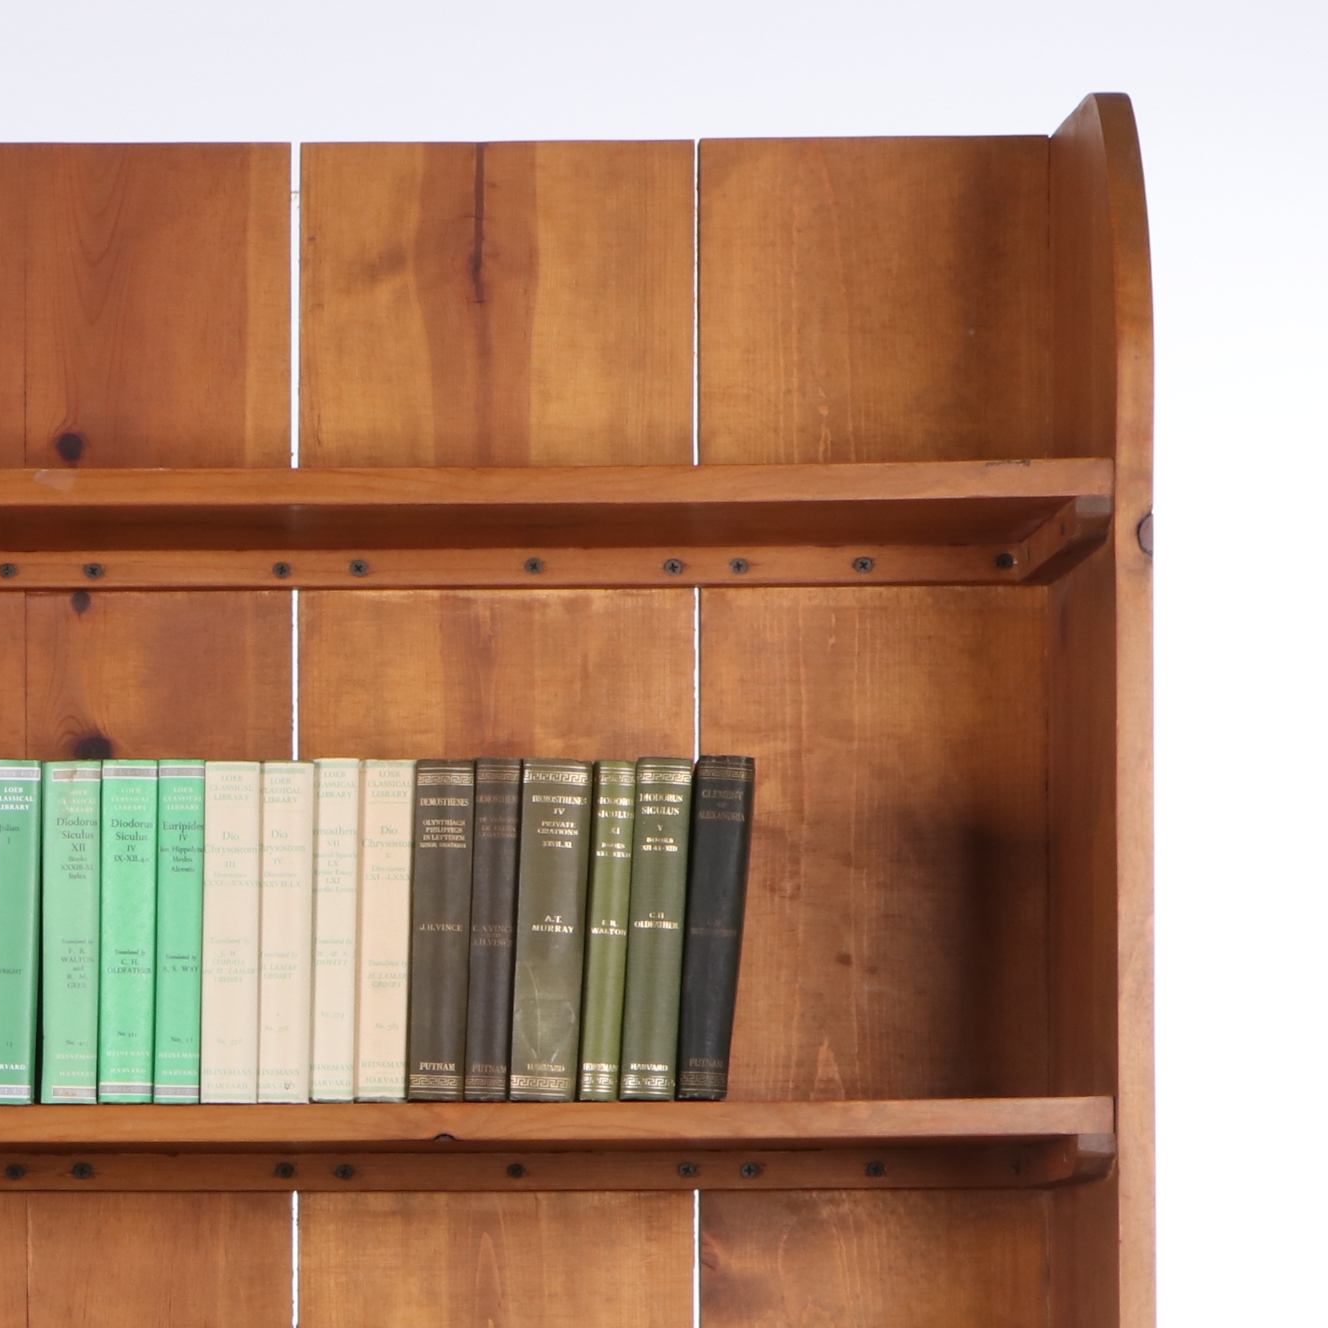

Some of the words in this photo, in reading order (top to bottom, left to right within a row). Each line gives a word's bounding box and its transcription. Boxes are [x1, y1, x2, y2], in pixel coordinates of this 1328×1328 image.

[4, 786, 24, 794] LOEB
[371, 790, 408, 798] LIBRARY
[701, 789, 744, 800] CLEMENT
[639, 793, 684, 804] DIODORUS
[641, 806, 680, 816] SICULUS
[56, 817, 98, 827] Diodorus
[111, 818, 153, 828] Diodorus
[0, 823, 20, 834] Julian
[380, 825, 398, 835] Dio
[61, 830, 94, 839] Siculus
[115, 831, 148, 841] Siculus
[222, 831, 239, 841] Dio
[270, 829, 288, 839] Dio
[71, 843, 86, 852] XII
[532, 924, 574, 934] MURRAY
[419, 1062, 456, 1071] PUTNAM
[630, 1062, 669, 1072] HARVARD
